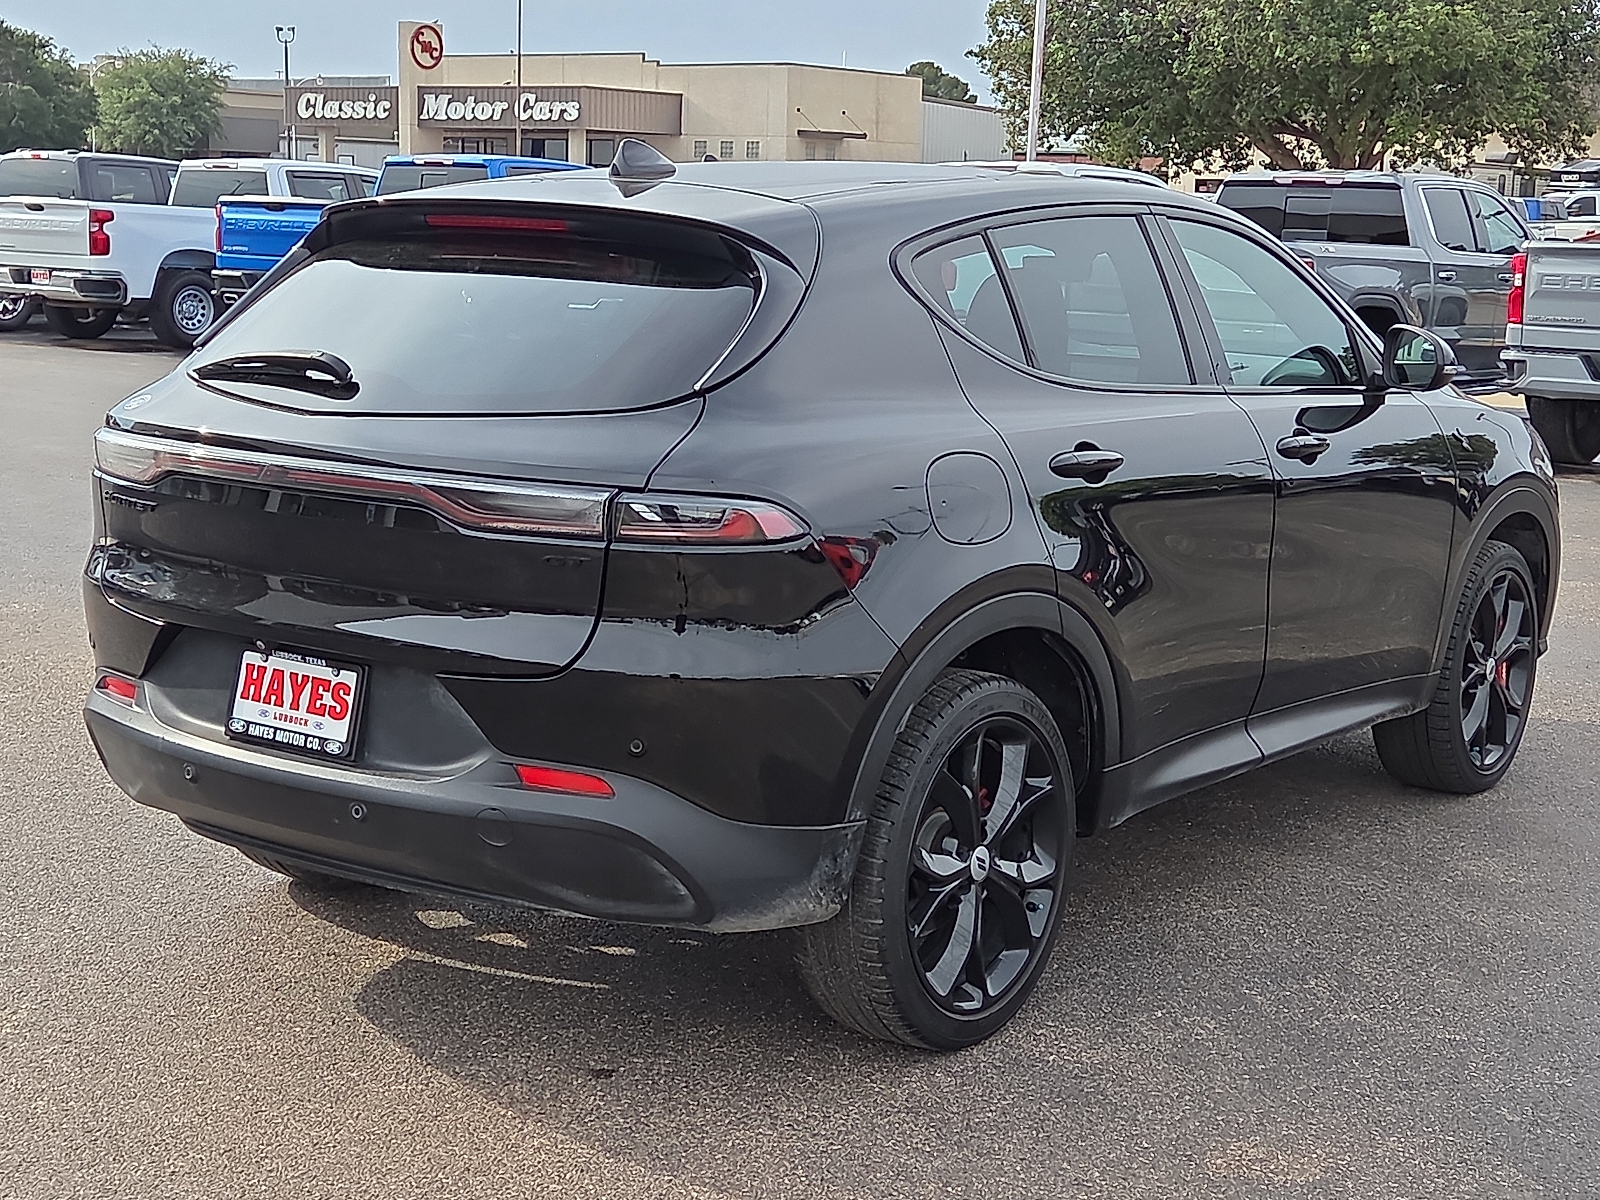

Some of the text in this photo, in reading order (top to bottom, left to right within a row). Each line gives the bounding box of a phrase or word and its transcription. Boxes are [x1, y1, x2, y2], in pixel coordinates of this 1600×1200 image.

[296, 92, 392, 120] Classic
[419, 92, 580, 122] Motor Cars
[225, 218, 317, 232] CHEVROLE
[305, 656, 327, 667] TEXAS
[240, 663, 352, 721] HAYES
[273, 711, 310, 727] LUBBOCK
[248, 723, 274, 739] HAYES
[275, 730, 305, 747] MOTOR
[306, 736, 321, 751] CO.
